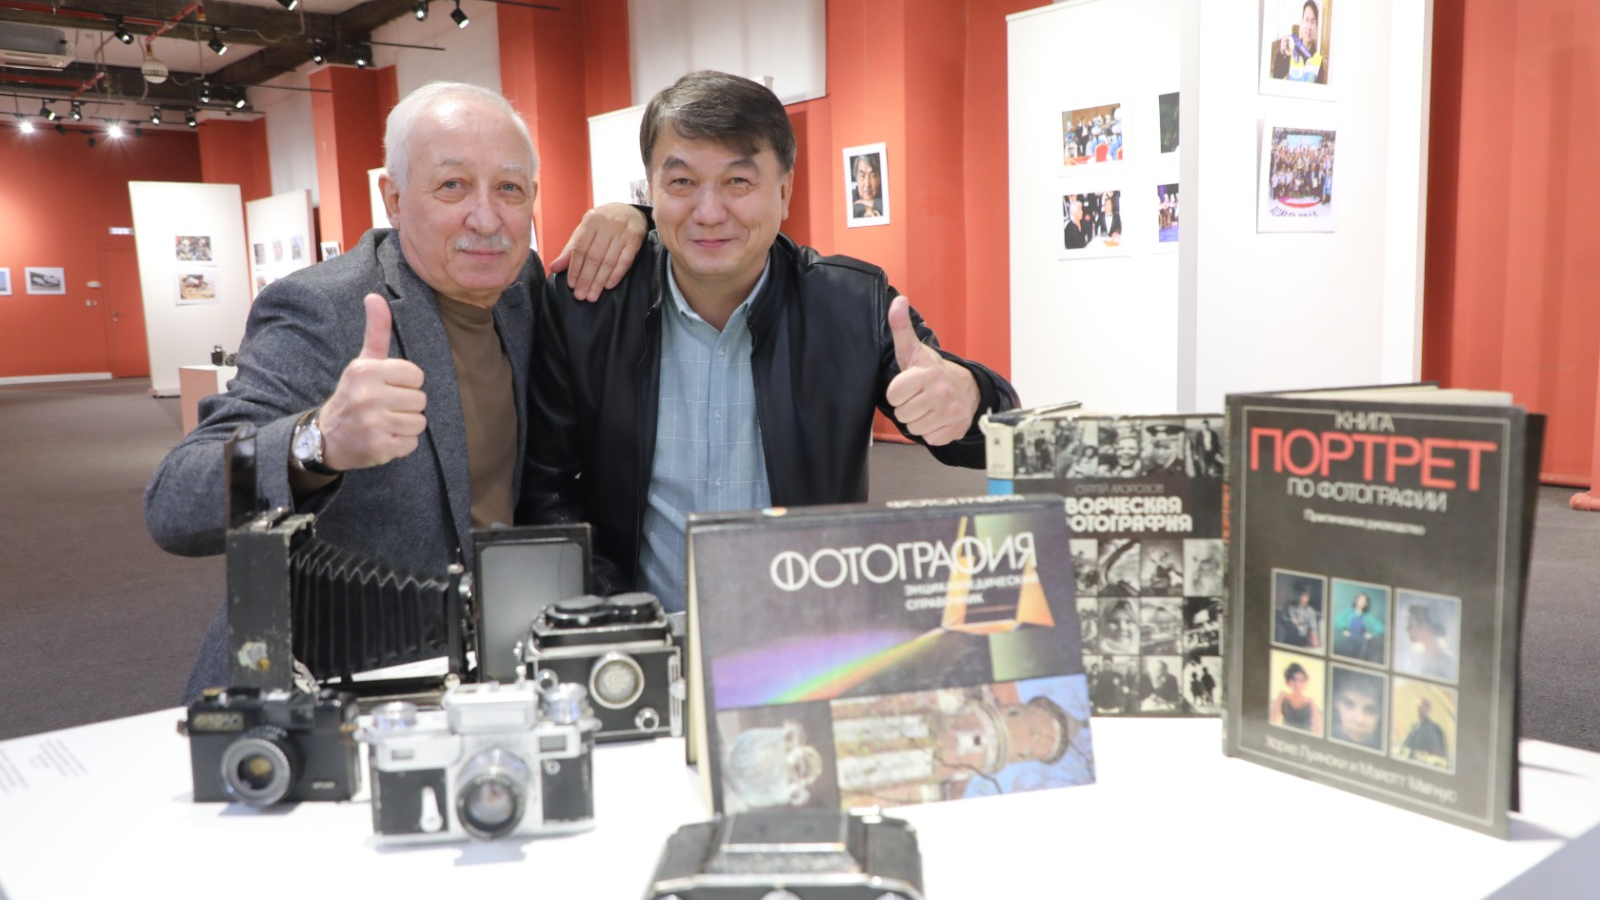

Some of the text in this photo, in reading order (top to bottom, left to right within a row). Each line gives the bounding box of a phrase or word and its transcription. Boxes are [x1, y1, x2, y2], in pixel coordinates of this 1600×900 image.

[1335, 410, 1396, 432] КНИГА
[1250, 427, 1498, 491] ПОРТРЕТ
[1065, 496, 1182, 515] ВОРЧЕСКАЯ
[1287, 477, 1447, 512] ПО ФОТОГРАФИИ
[1066, 514, 1193, 532] ОТОГРАФИЯ
[770, 531, 1037, 591] ФОТОГРАФИЯ
